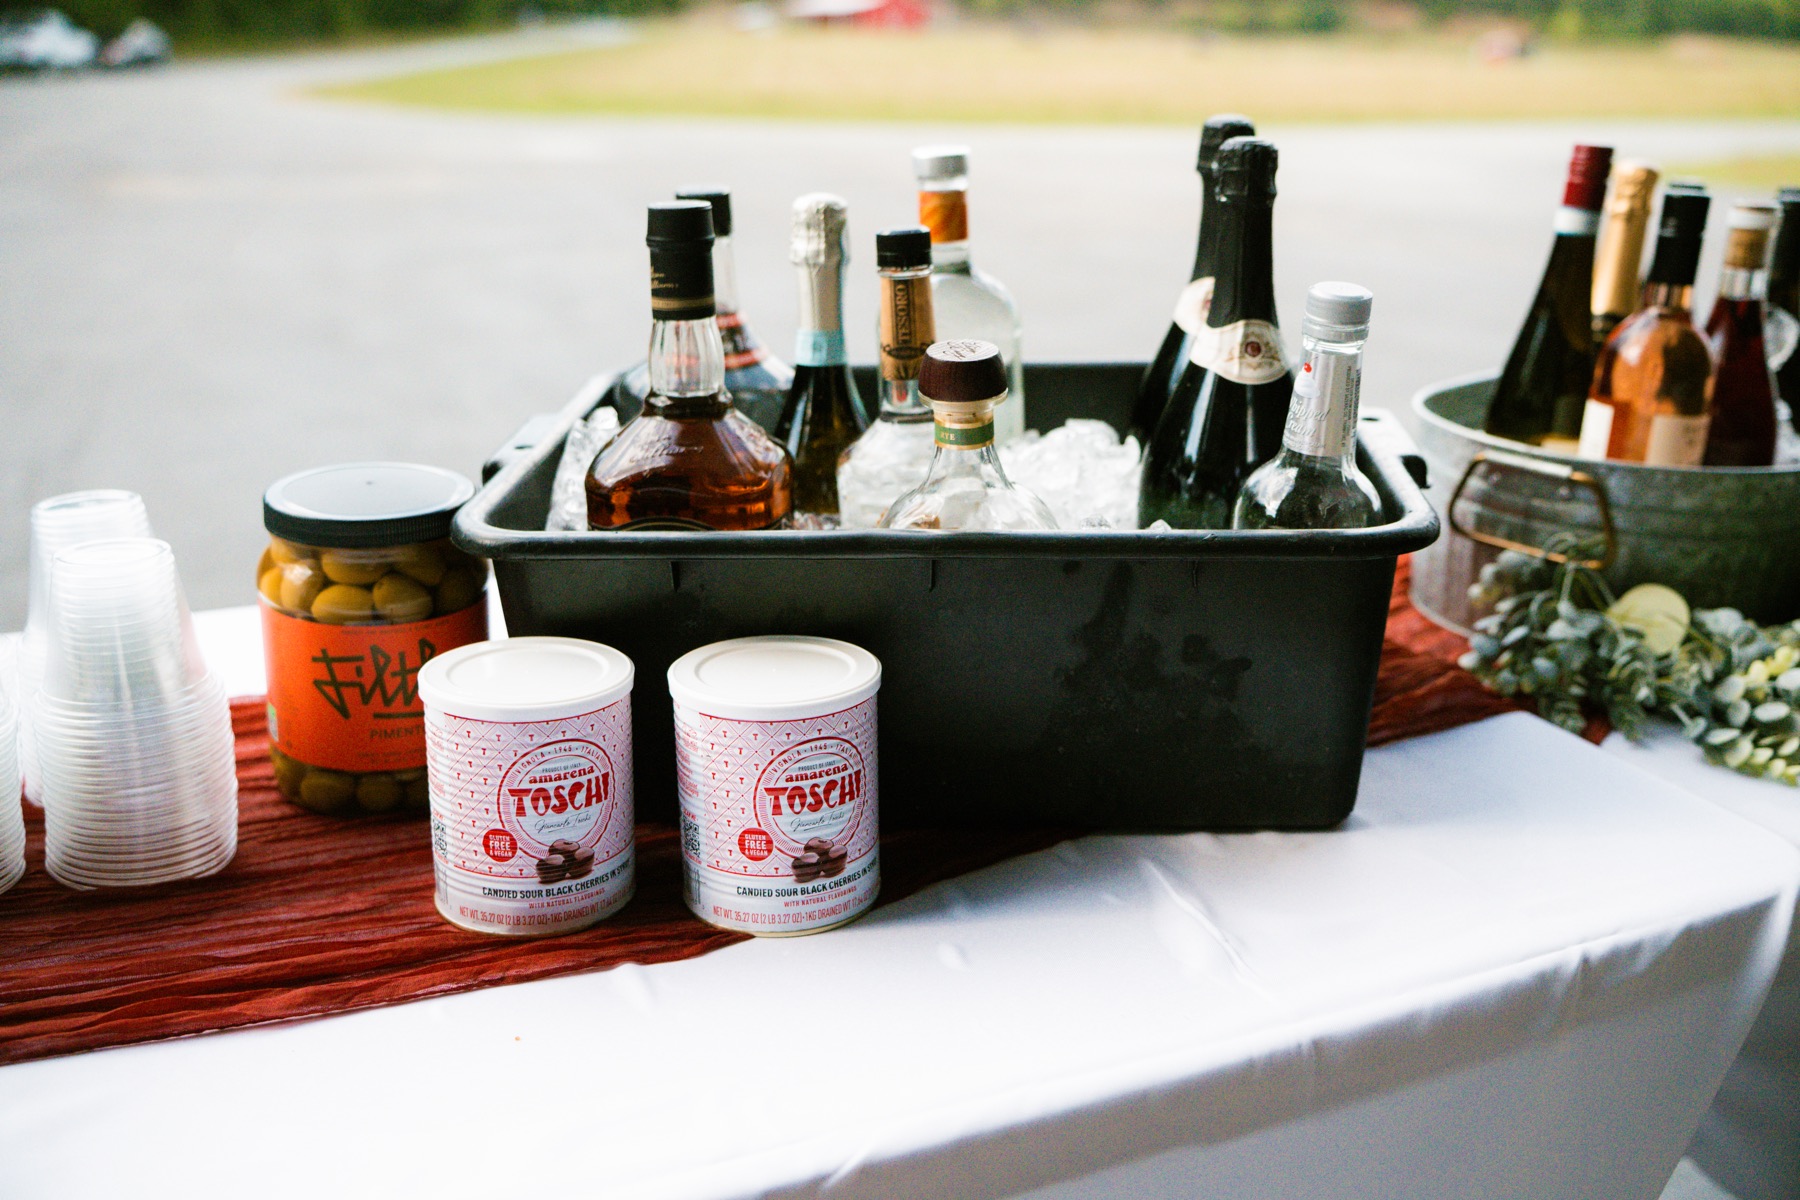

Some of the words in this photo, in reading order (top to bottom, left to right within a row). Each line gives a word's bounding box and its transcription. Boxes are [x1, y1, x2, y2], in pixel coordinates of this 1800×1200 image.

[895, 284, 910, 344] TESORO
[370, 724, 425, 739] PIMENT
[514, 751, 546, 774] VIGNOLA
[580, 745, 602, 761] ITALIA
[771, 749, 802, 773] VIGNOLA
[809, 742, 828, 753] 1945
[798, 763, 818, 772] PRODUCT
[528, 765, 595, 784] amarena
[785, 763, 849, 783] amarena
[507, 771, 610, 817] TOSCHI
[763, 768, 862, 816] TOSCHI
[489, 841, 511, 850] FREE
[745, 840, 767, 849] FREE
[482, 886, 518, 899] CANDIED
[520, 888, 544, 899] SOUR
[545, 884, 574, 897] BLACK
[575, 873, 610, 892] CHERRIES
[736, 886, 773, 898] CANDIED
[775, 887, 798, 898] SOUR
[800, 883, 828, 896] BLACK
[828, 871, 862, 890] CHERRIES
[546, 897, 573, 908] NATURAL
[801, 896, 827, 907] NATURAL
[828, 886, 857, 901] FLAVORINGS
[459, 905, 469, 918] NET
[480, 910, 496, 922] 35.27
[498, 913, 506, 925] OZ
[512, 913, 521, 925] LB
[522, 912, 536, 926] 3.27
[563, 906, 590, 922] DRAINED
[713, 906, 723, 917] NET
[723, 907, 733, 919] WT.
[734, 910, 750, 923] 35.27
[751, 912, 760, 924] OZ
[768, 913, 777, 925] LB
[777, 912, 791, 924] 3.27
[817, 904, 843, 920] DRAINED
